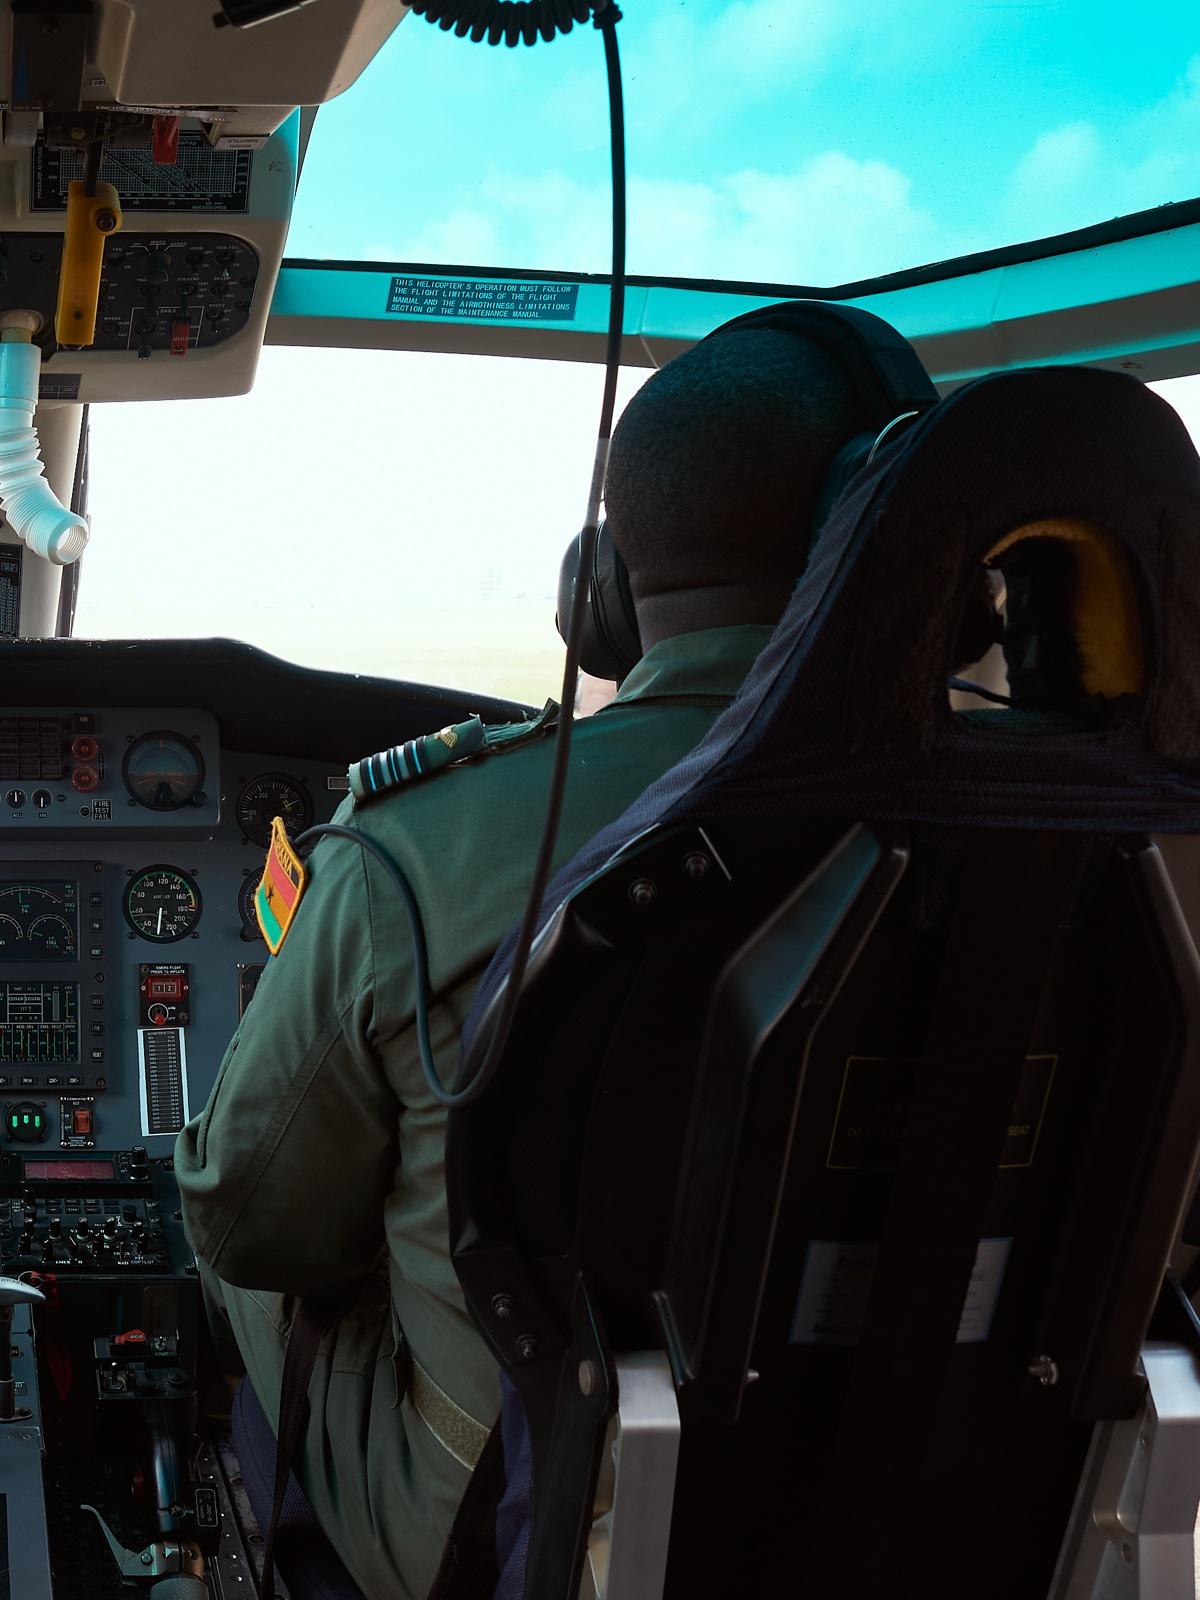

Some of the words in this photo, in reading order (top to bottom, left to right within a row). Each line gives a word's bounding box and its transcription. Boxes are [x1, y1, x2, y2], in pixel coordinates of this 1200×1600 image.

[395, 278, 413, 287] THIS
[416, 279, 472, 290] HELICOPTER'S
[474, 283, 518, 292] OPERATION
[520, 284, 539, 292] MUST
[542, 285, 572, 293] FOLLOW
[394, 286, 408, 295] THE
[411, 288, 439, 297] FLIGHT
[442, 290, 493, 299] LIMITATIONS
[496, 292, 506, 300] OF
[511, 293, 525, 301] THE
[528, 293, 557, 301] FLIGHT
[392, 295, 420, 305] MANUAL
[423, 298, 438, 306] AND
[442, 299, 456, 307] THE
[518, 303, 571, 311] LIMITATIONS
[390, 304, 423, 313] SECTION
[426, 306, 437, 314] OF
[440, 307, 455, 315] THE
[457, 308, 509, 318] MAINTENANCE
